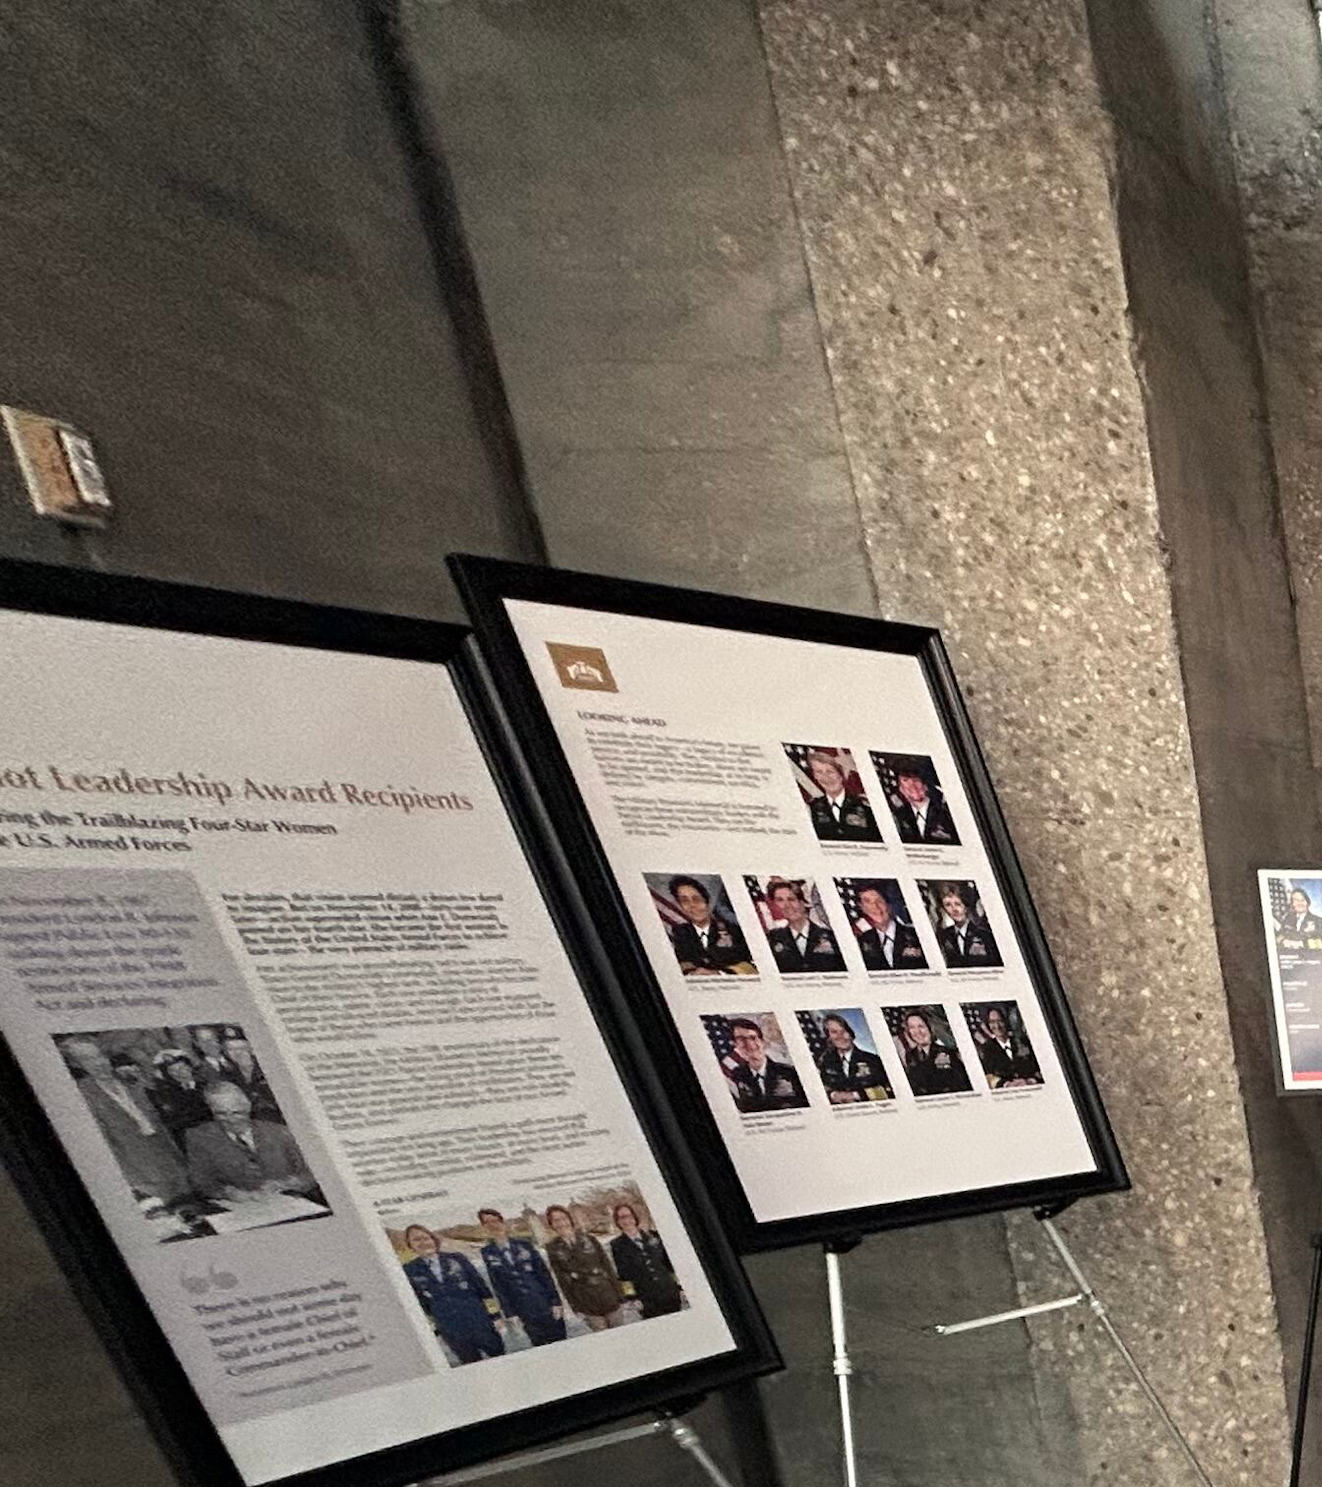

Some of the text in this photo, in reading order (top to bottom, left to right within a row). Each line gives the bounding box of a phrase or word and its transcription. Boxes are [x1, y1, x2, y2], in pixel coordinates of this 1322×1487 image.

[50, 765, 231, 806] Leadership
[244, 778, 338, 803] Award
[341, 783, 474, 813] Recipients
[40, 809, 74, 827] the
[73, 811, 190, 835] Trailblazing
[189, 817, 267, 832] Four-Star
[269, 819, 338, 836] Women
[13, 832, 60, 849] U.S.
[65, 834, 129, 850] Armed
[128, 836, 193, 851] Forces
